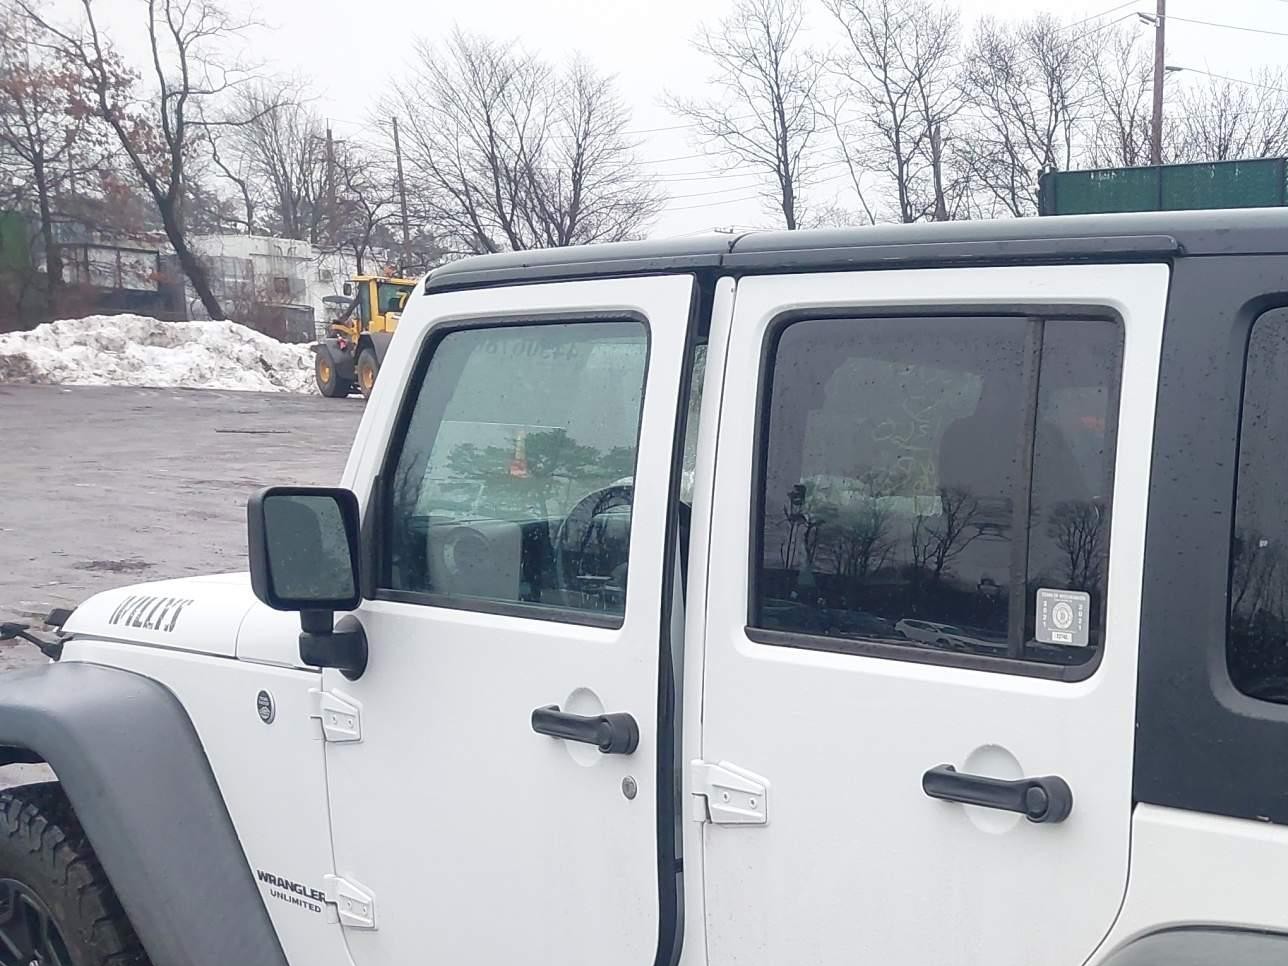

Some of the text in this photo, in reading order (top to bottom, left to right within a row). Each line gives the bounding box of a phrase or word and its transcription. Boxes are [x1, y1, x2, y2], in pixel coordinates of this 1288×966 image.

[108, 596, 194, 632] WILLYS
[257, 870, 326, 902] WRANGLER
[270, 888, 322, 913] UNLIMITED
